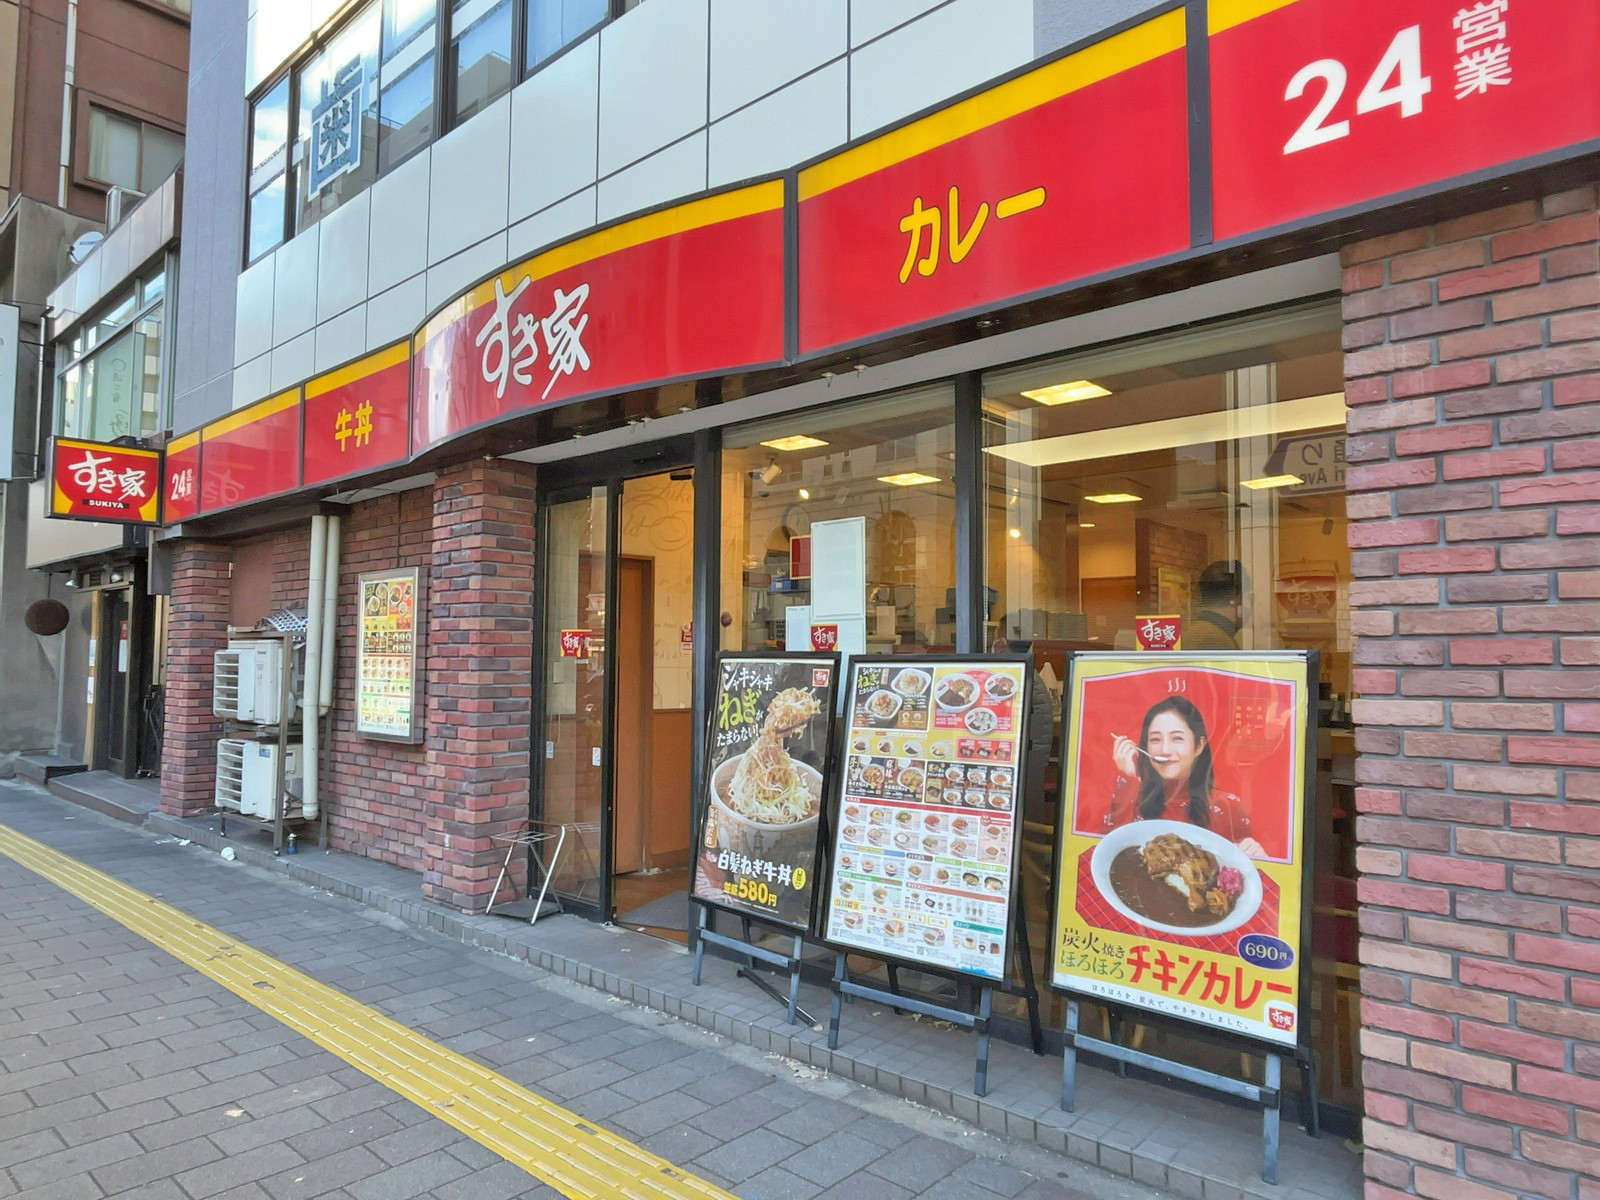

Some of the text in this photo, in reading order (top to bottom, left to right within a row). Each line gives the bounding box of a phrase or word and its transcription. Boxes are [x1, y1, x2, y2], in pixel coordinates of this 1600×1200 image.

[1283, 0, 1512, 155] 24 営業
[898, 184, 1047, 284] カレー
[476, 274, 592, 400] すき家
[335, 399, 373, 452] 牛丼
[67, 450, 147, 501] すき家
[171, 469, 186, 501] 24
[88, 500, 125, 509] SUKIYA
[813, 626, 835, 646] すき家
[1141, 618, 1177, 644] すき家
[722, 665, 773, 692] シャキシャキ
[718, 849, 792, 887] 白髪ねぎ牛丼
[1062, 927, 1125, 959] 炭火焼き
[1245, 941, 1287, 961] 690円
[1060, 950, 1125, 979] ほろほろ
[1126, 945, 1293, 1010] チキンカレー
